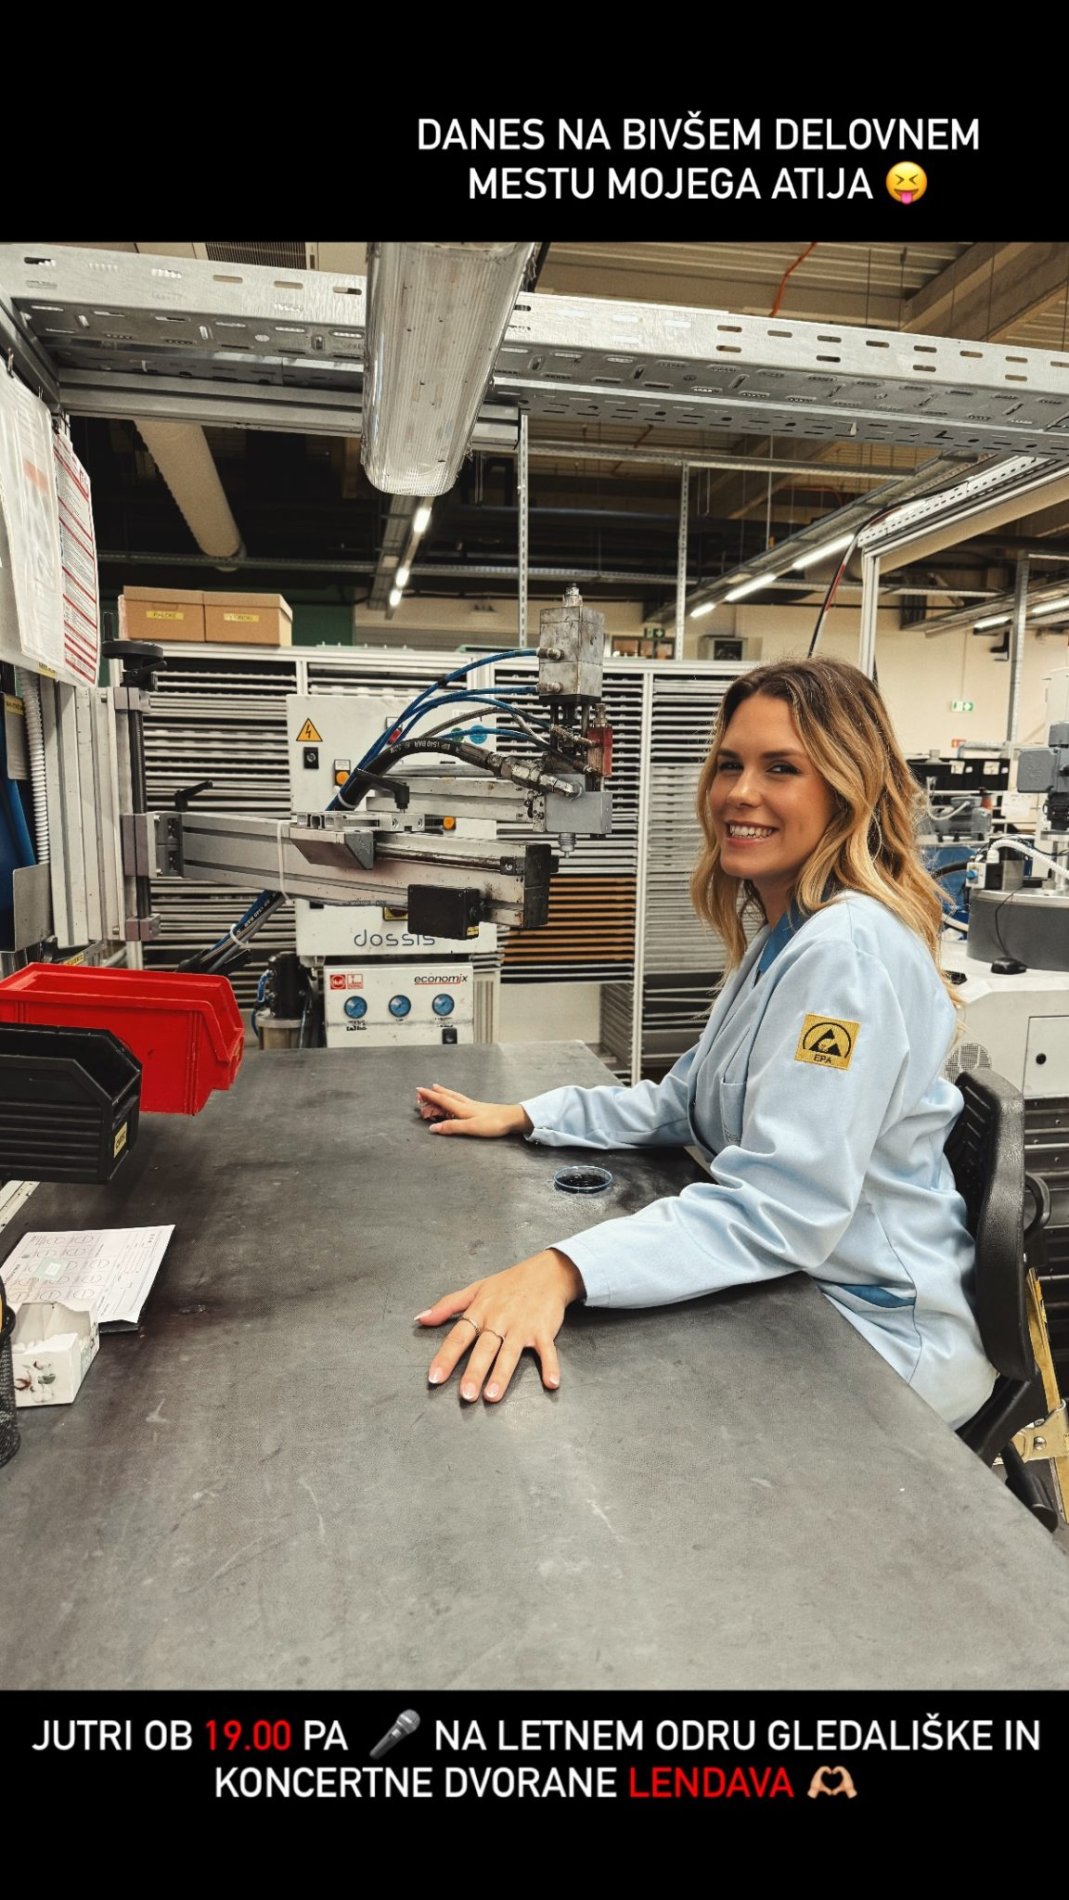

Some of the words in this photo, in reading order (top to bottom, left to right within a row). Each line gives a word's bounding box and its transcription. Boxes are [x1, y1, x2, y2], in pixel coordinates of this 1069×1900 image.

[353, 928, 436, 947] dossis
[414, 973, 469, 984] economix
[813, 1054, 832, 1064] EPA
